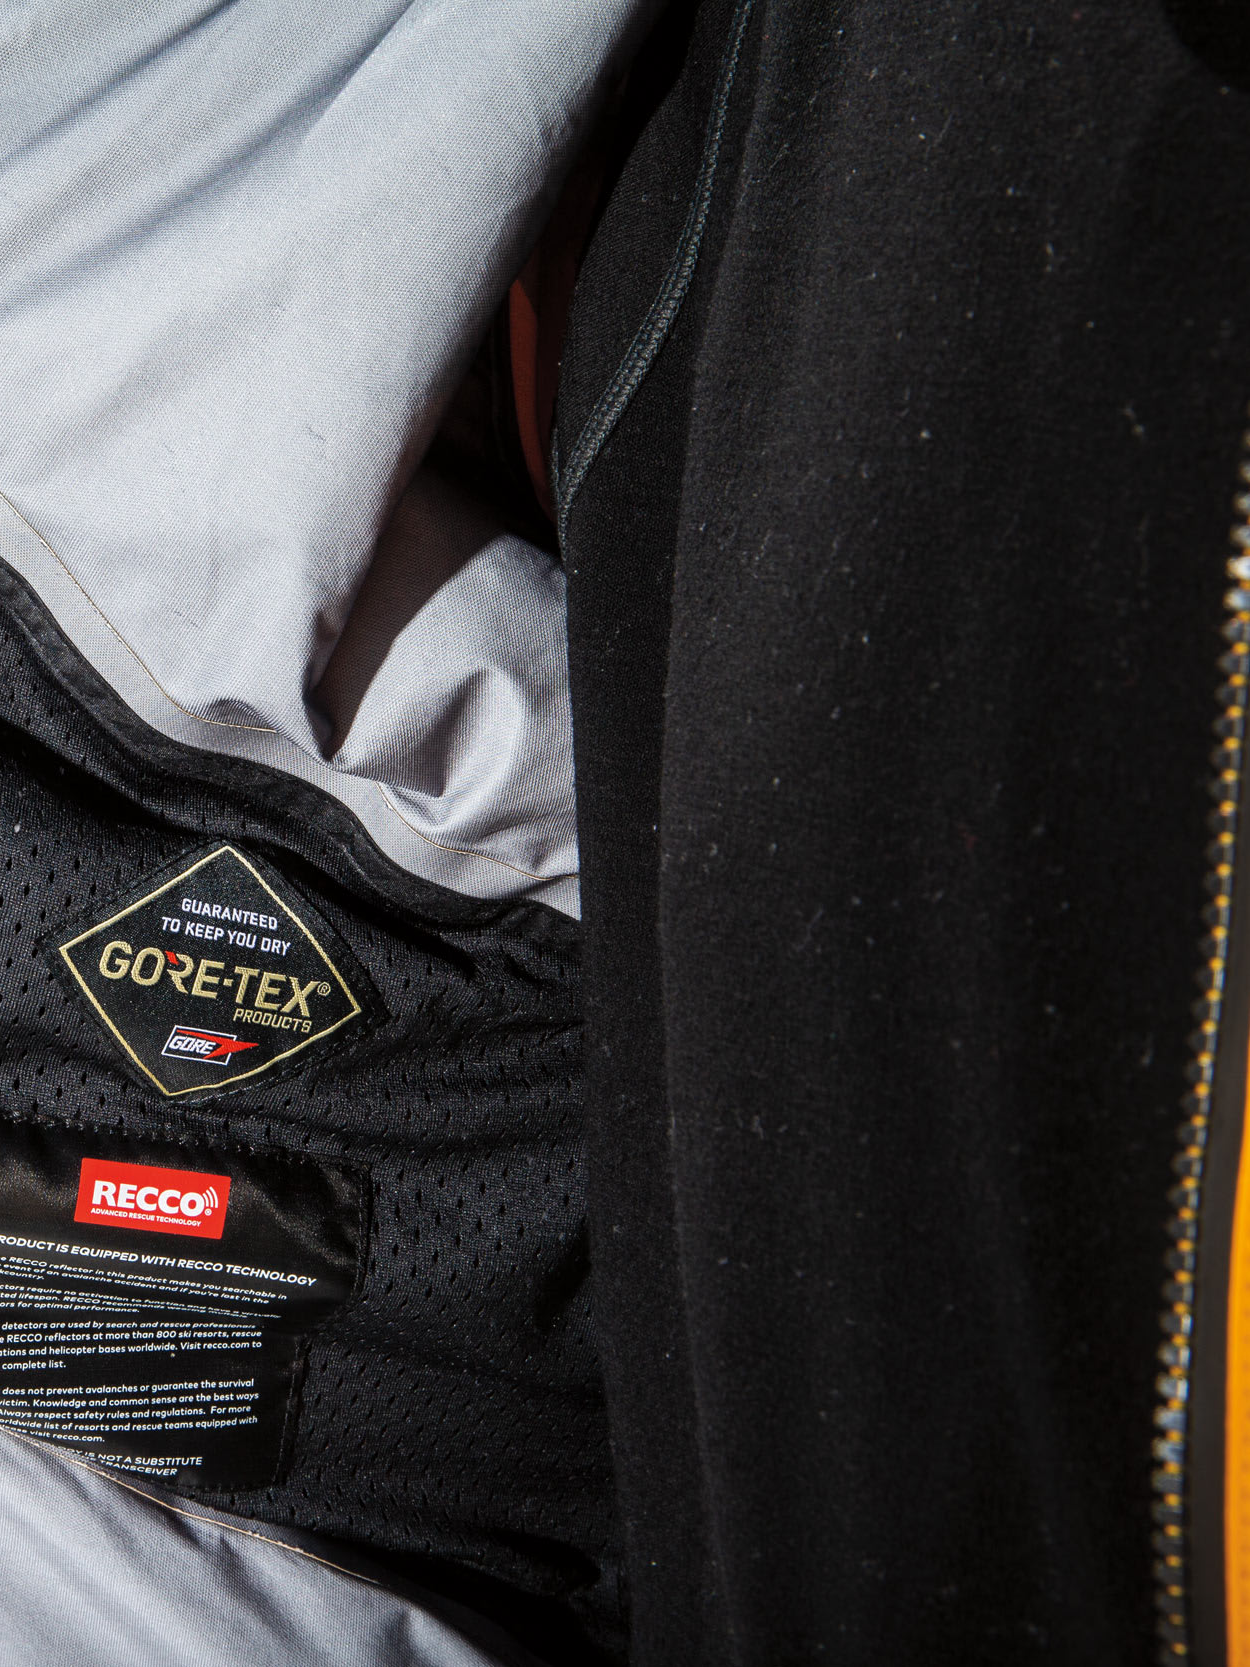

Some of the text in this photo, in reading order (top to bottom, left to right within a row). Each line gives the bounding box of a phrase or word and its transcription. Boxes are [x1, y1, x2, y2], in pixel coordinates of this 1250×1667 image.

[181, 898, 278, 931] GUARANTEED
[162, 916, 291, 957] TO KEEP YOU DRY
[233, 1008, 312, 1033] PRODUCTS
[169, 1035, 218, 1056] GORE
[90, 1207, 201, 1227] ADVANCED RESCUE TECHNOLOGY
[56, 1243, 69, 1253] IS
[71, 1245, 139, 1262] EQUIPPED
[141, 1254, 176, 1267] WITH
[177, 1259, 223, 1272] RECCO
[225, 1264, 317, 1287] TECHNOLOGY
[3, 1264, 31, 1272] event
[61, 1272, 112, 1283] avalanche
[114, 1279, 157, 1289] accident
[188, 1289, 219, 1298] you're
[9, 1256, 47, 1267] RECCO
[49, 1263, 94, 1274] reflector
[107, 1270, 126, 1279] this
[127, 1274, 168, 1284] product
[169, 1280, 201, 1288] makes
[222, 1286, 277, 1299] searchable
[18, 1293, 60, 1302] lifespan.
[63, 1296, 101, 1304] RECCO
[102, 1300, 165, 1309] recommends
[26, 1286, 62, 1295] require
[78, 1291, 129, 1302] activation
[34, 1302, 73, 1310] optimal
[74, 1304, 140, 1313] performance.
[2, 1321, 48, 1330] detectors
[92, 1321, 104, 1329] by
[6, 1333, 42, 1343] RECCO
[44, 1332, 91, 1341] reflectors
[93, 1332, 103, 1340] at
[105, 1332, 131, 1340] more
[132, 1330, 154, 1339] than
[156, 1330, 177, 1339] 800
[178, 1330, 191, 1338] ski
[193, 1331, 230, 1339] resorts,
[28, 1346, 47, 1355] and
[49, 1345, 96, 1356] helicopter
[98, 1345, 126, 1354] bases
[128, 1342, 178, 1352] worldwide.
[180, 1341, 201, 1350] Visit
[2, 1360, 47, 1371] complete
[48, 1359, 67, 1368] list.
[2, 1387, 26, 1395] does
[27, 1387, 44, 1395] not
[46, 1386, 84, 1396] prevent
[85, 1384, 138, 1394] avalanches
[151, 1381, 199, 1393] guarantee
[200, 1379, 217, 1388] the
[218, 1378, 254, 1388] survival
[33, 1398, 86, 1409] Knowledge
[89, 1398, 107, 1406] and
[196, 1393, 211, 1401] the
[213, 1393, 234, 1401] best
[236, 1393, 259, 1401] ways
[34, 1411, 71, 1420] respect
[73, 1411, 105, 1420] safety
[107, 1410, 130, 1419] rules
[132, 1409, 150, 1418] and
[151, 1407, 206, 1419] regulations.
[211, 1405, 227, 1414] For
[228, 1405, 251, 1413] more
[44, 1422, 59, 1430] list
[61, 1422, 73, 1430] of
[112, 1423, 130, 1431] and
[132, 1423, 162, 1431] rescue
[164, 1421, 193, 1429] teams
[195, 1418, 237, 1429] equipped
[239, 1415, 258, 1425] with
[30, 1430, 50, 1438] visit
[53, 1433, 105, 1442] recco.com.
[97, 1453, 123, 1461] NOT
[124, 1455, 132, 1463] A
[134, 1456, 203, 1466] SUBSTITUTE
[101, 1460, 178, 1476] TRANSCEIVER
